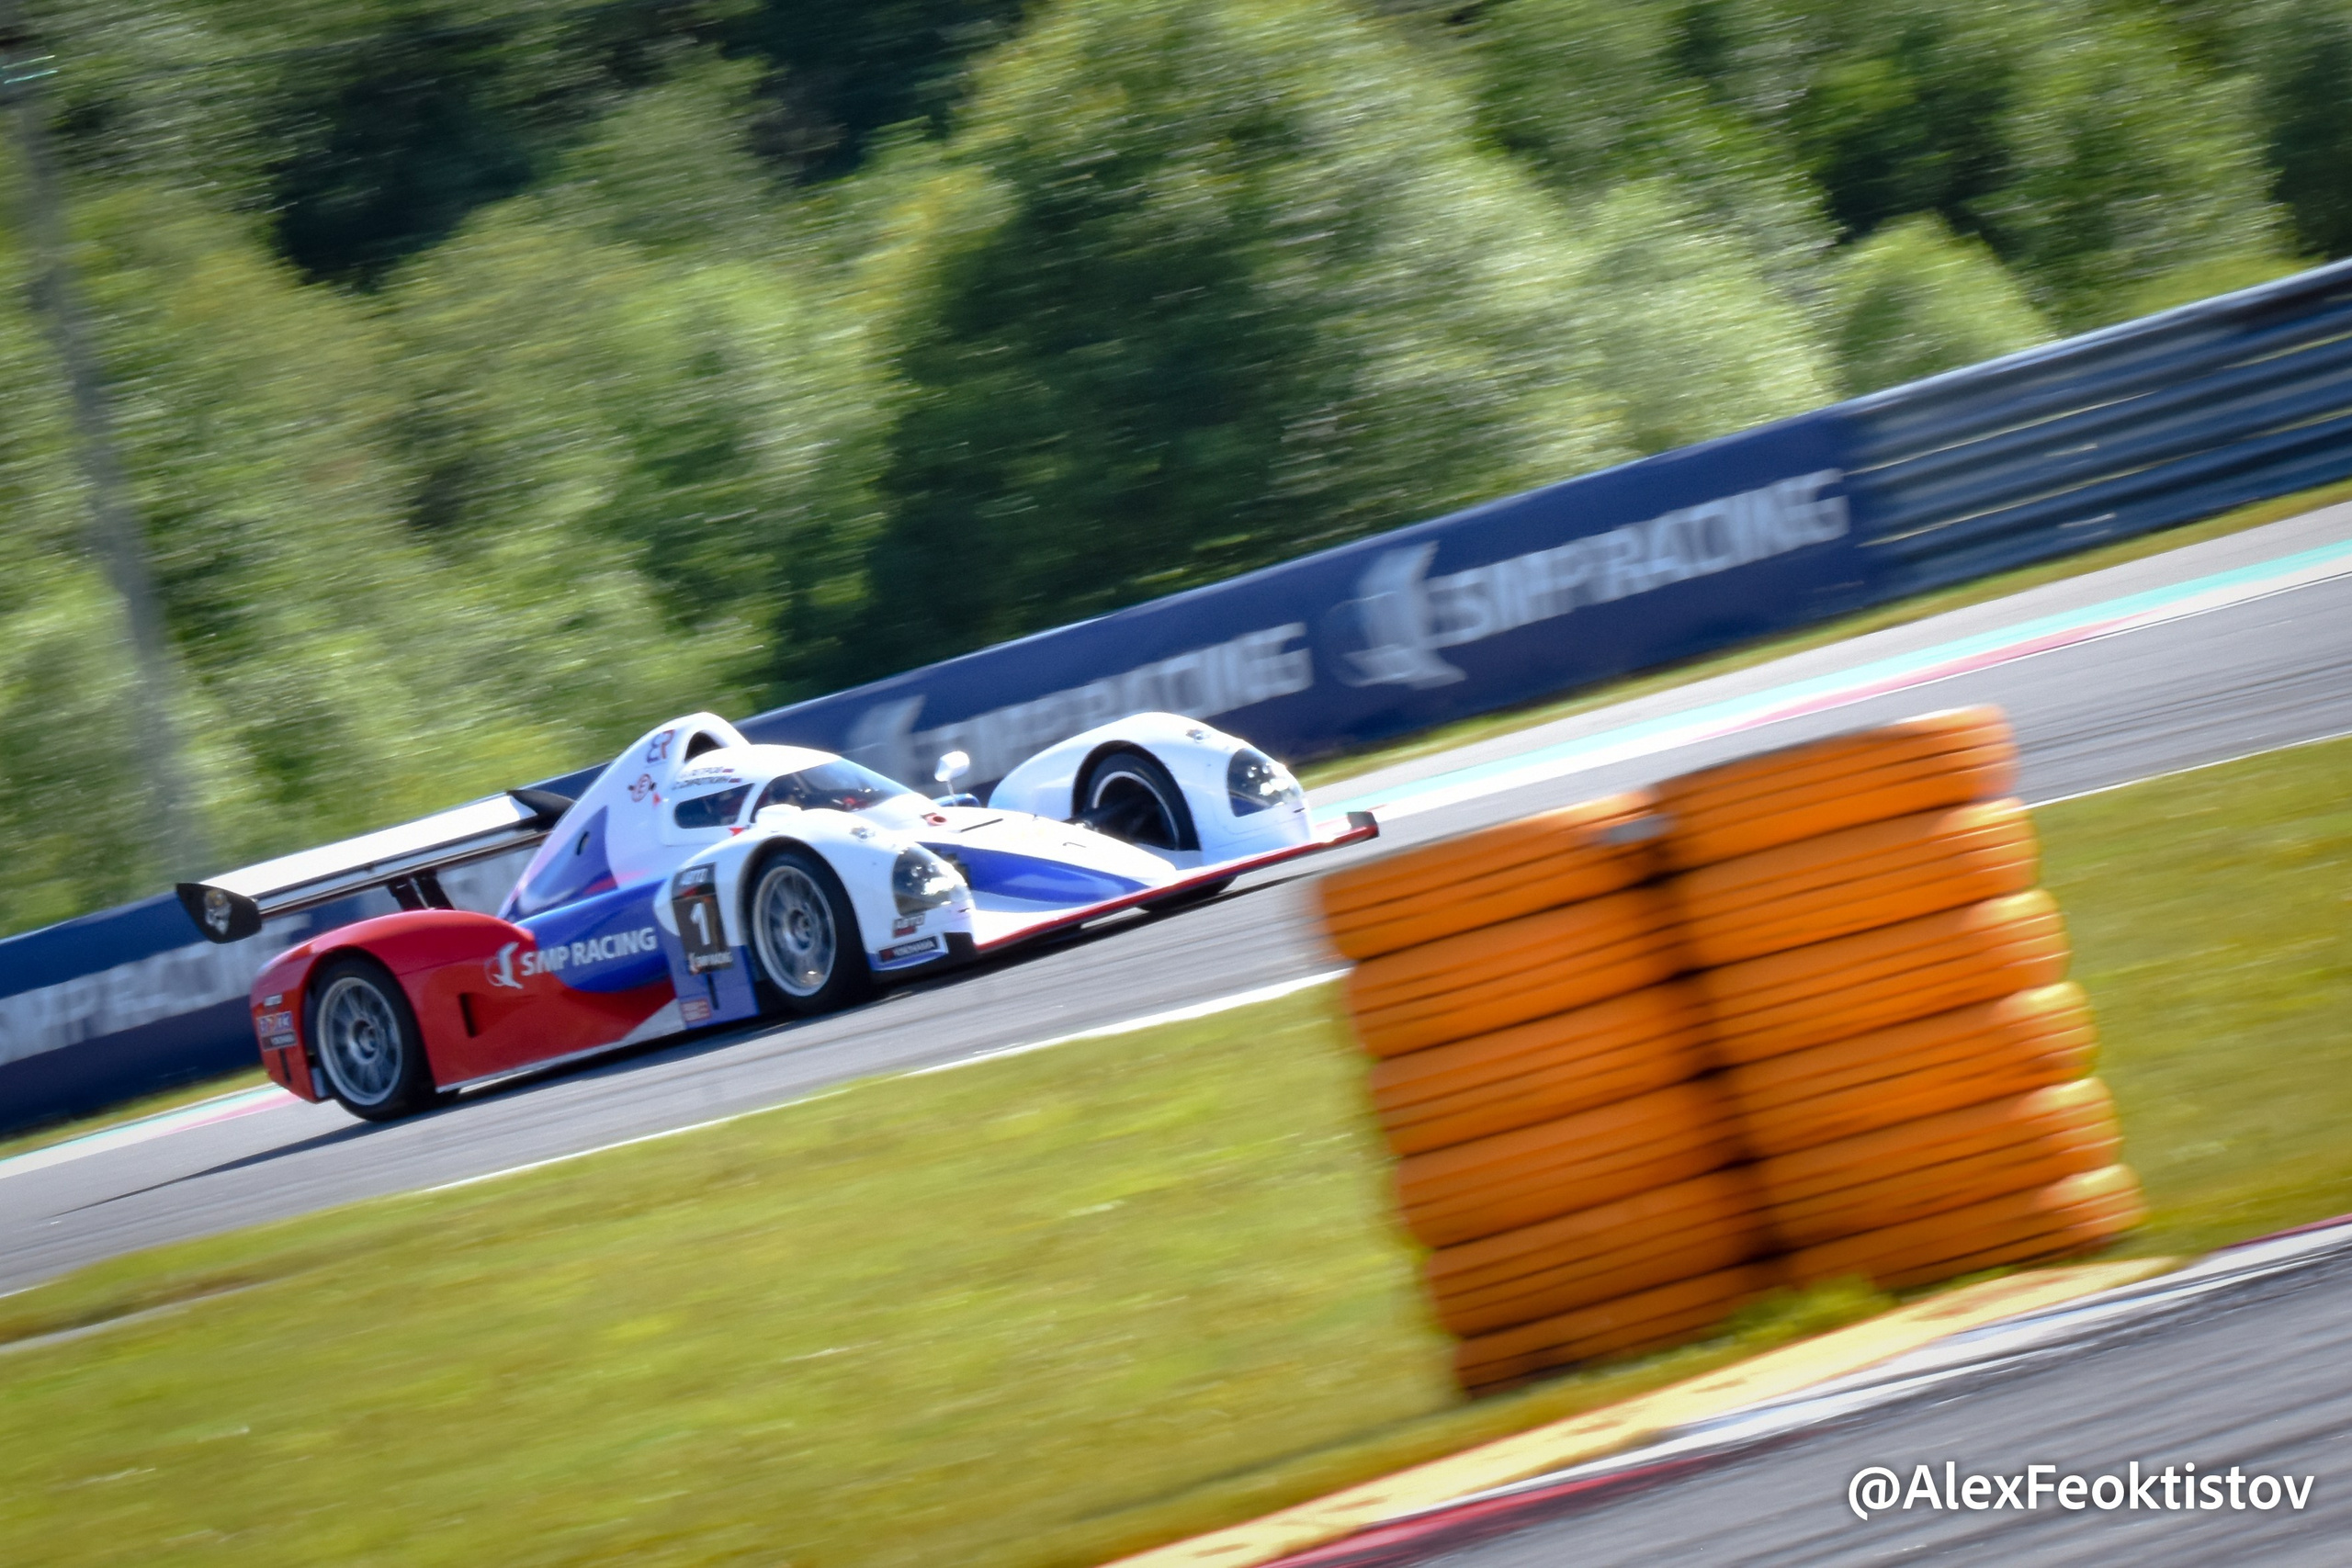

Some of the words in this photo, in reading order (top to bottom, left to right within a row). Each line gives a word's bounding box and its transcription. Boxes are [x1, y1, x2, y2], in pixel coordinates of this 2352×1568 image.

[691, 902, 710, 946] 1
[520, 947, 570, 976] SMP
[571, 927, 658, 966] RACING
